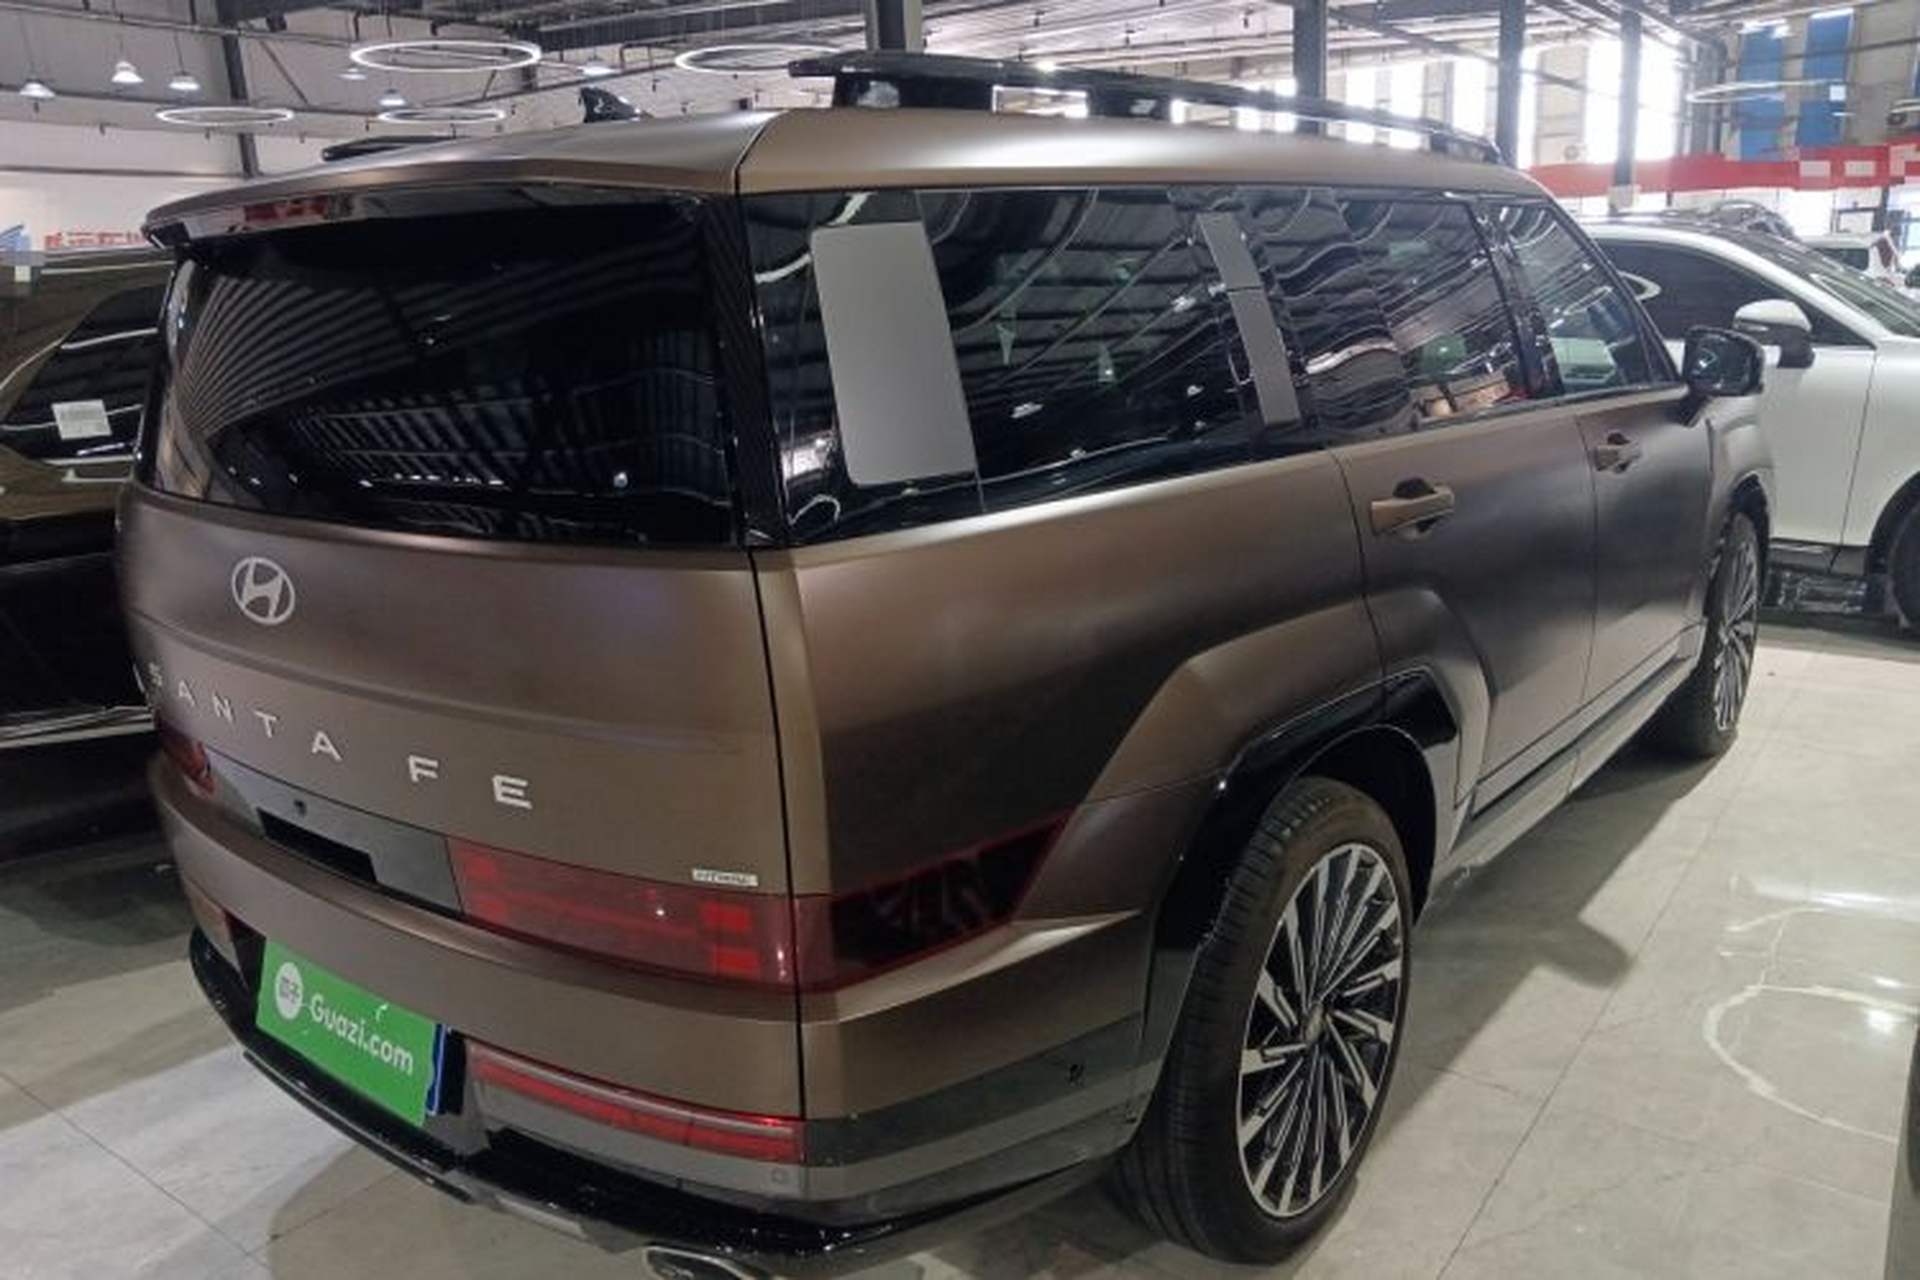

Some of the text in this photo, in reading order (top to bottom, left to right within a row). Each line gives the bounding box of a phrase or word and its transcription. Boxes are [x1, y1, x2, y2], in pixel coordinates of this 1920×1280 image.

[149, 662, 533, 810] SANTA FE
[310, 993, 414, 1077] Guazi.com
